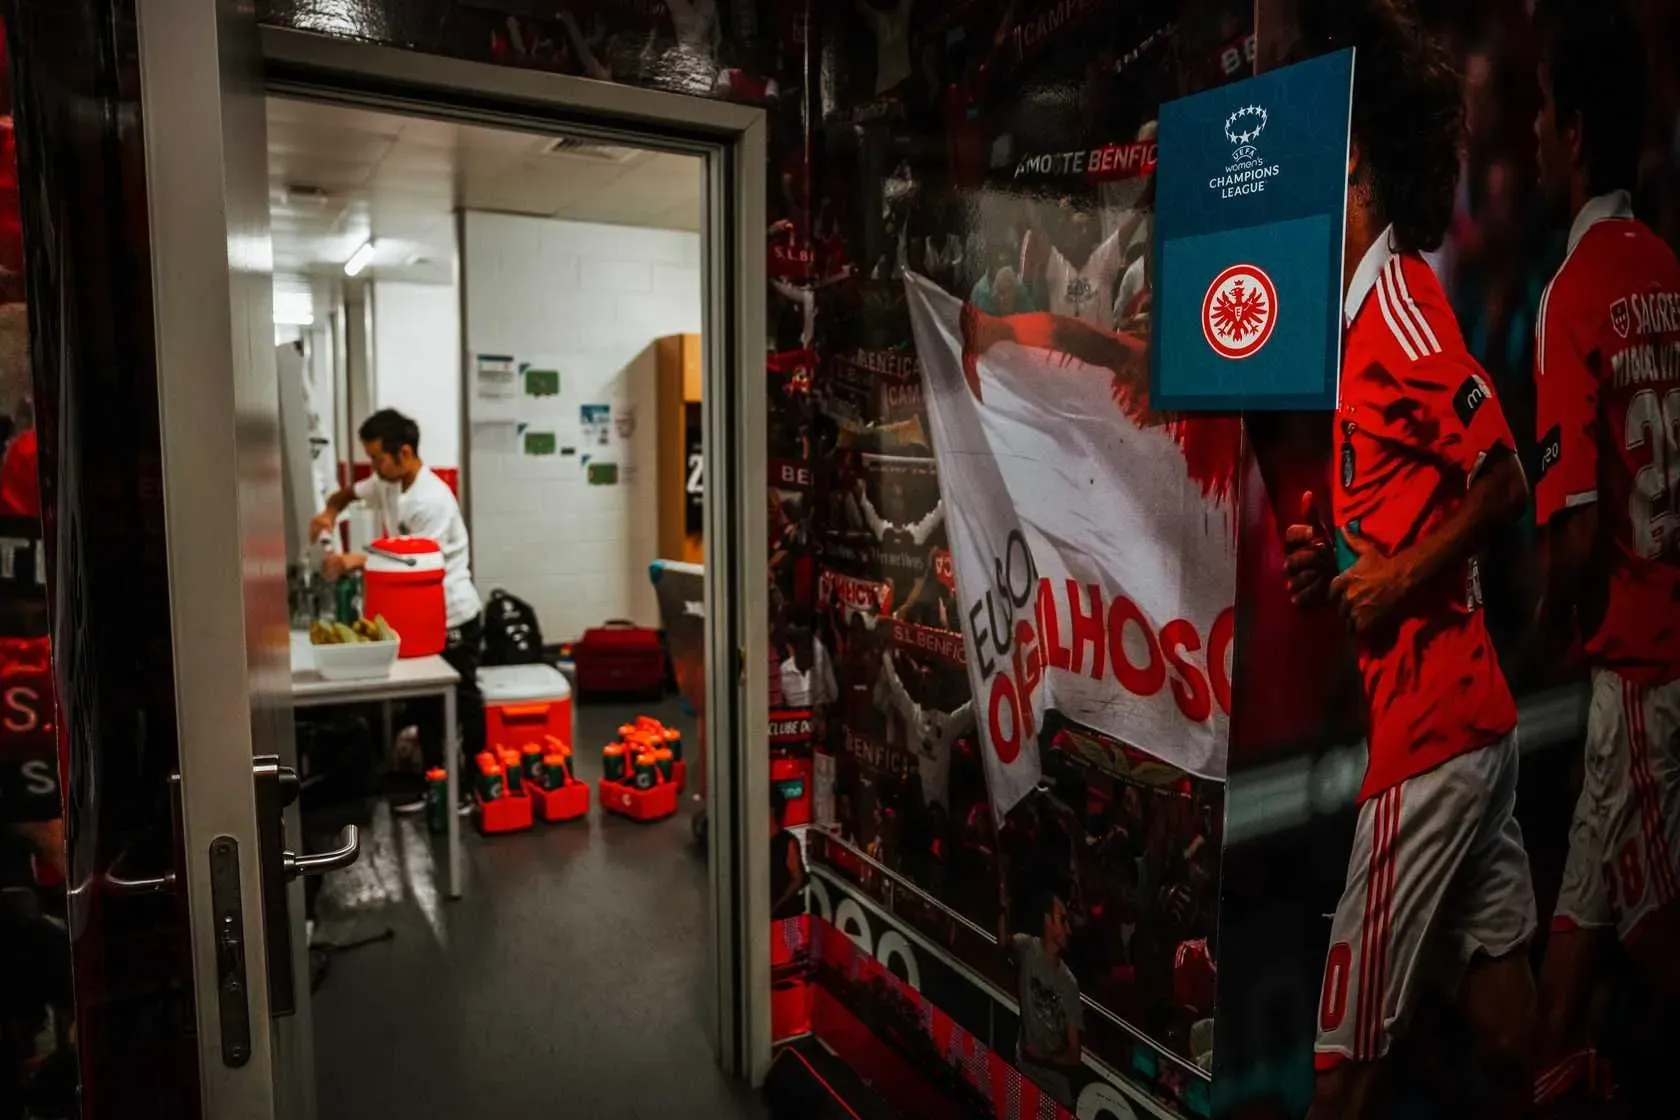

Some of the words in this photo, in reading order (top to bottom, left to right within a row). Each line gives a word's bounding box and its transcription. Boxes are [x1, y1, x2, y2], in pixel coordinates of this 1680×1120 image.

[1232, 147, 1255, 160] UEFA
[1225, 158, 1264, 173] women's
[1209, 164, 1280, 189] CHAMPIONS
[1221, 180, 1265, 199] LEAGUE
